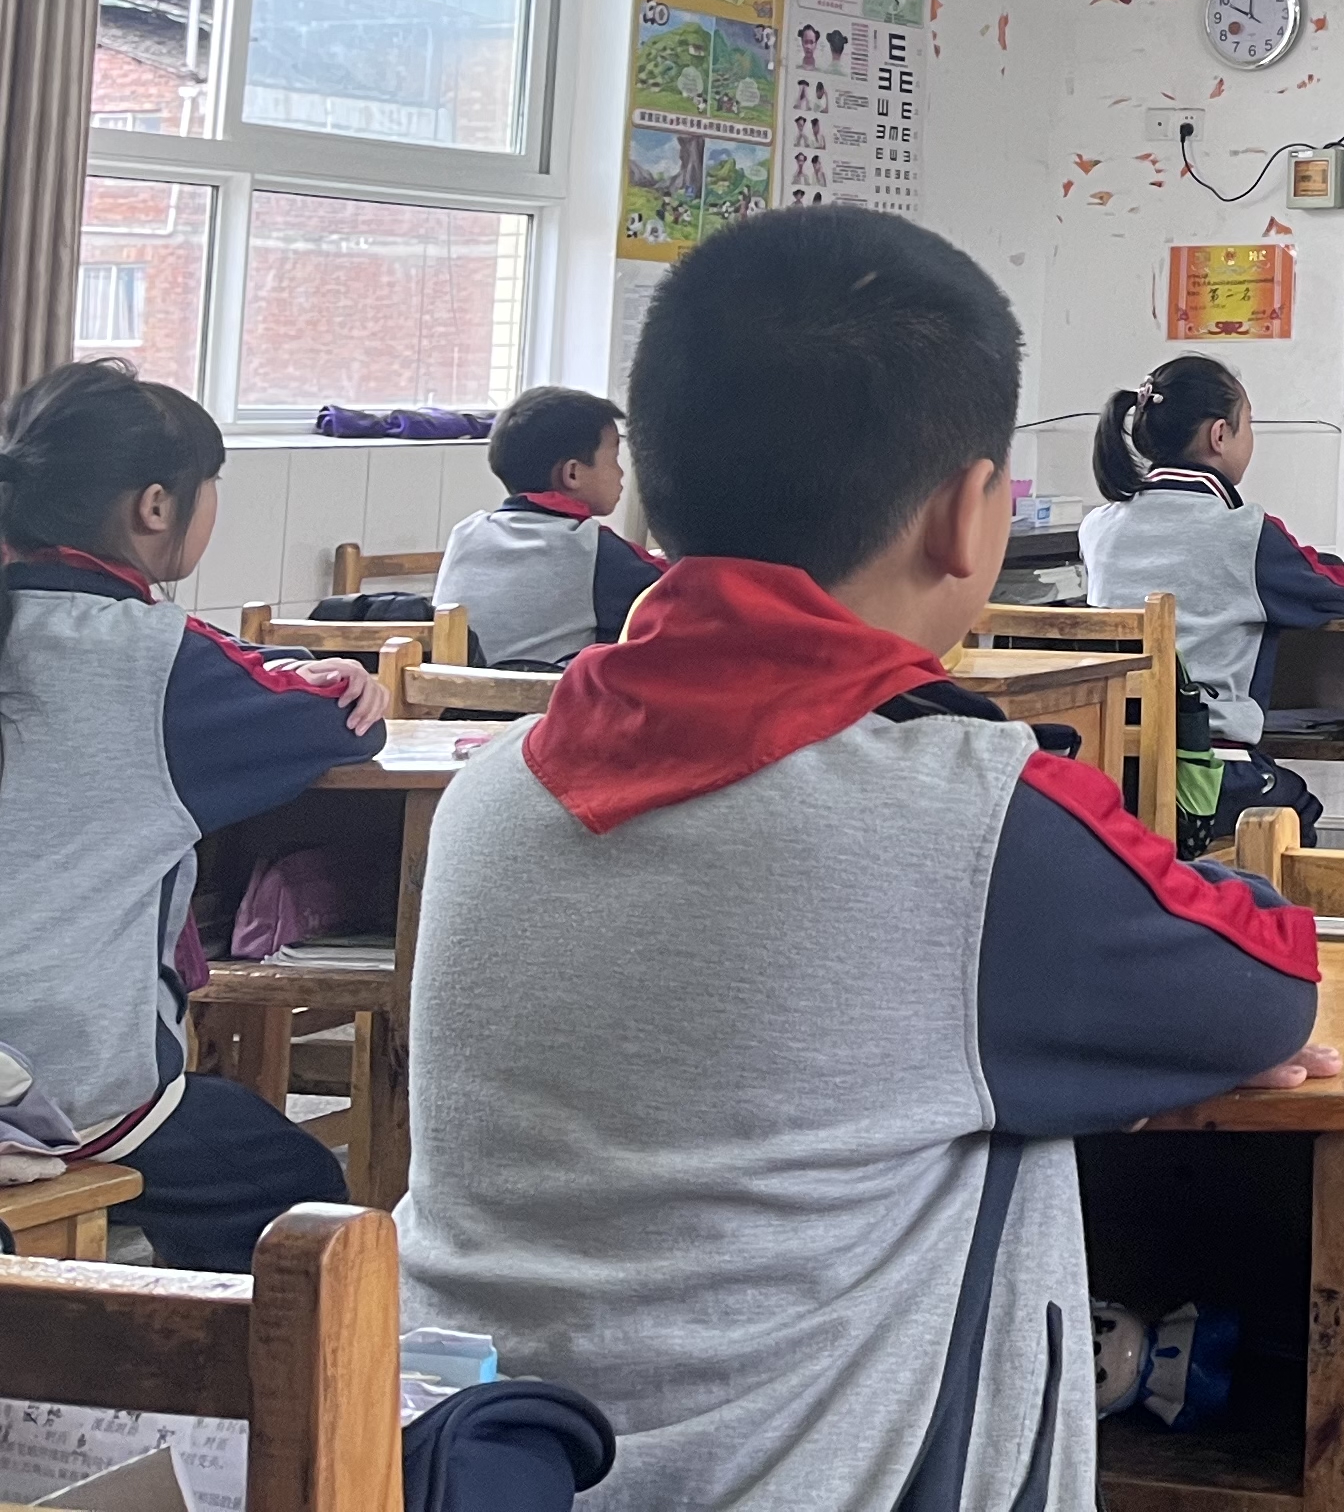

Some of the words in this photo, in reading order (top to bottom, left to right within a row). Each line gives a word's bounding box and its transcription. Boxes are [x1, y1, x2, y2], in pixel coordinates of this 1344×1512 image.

[1213, 11, 1222, 24] 9
[1281, 7, 1289, 20] 3
[1219, 29, 1228, 42] 8
[1276, 26, 1284, 37] 4
[1232, 41, 1240, 53] 7
[1248, 44, 1257, 57] 6
[1264, 39, 1273, 52] 5
